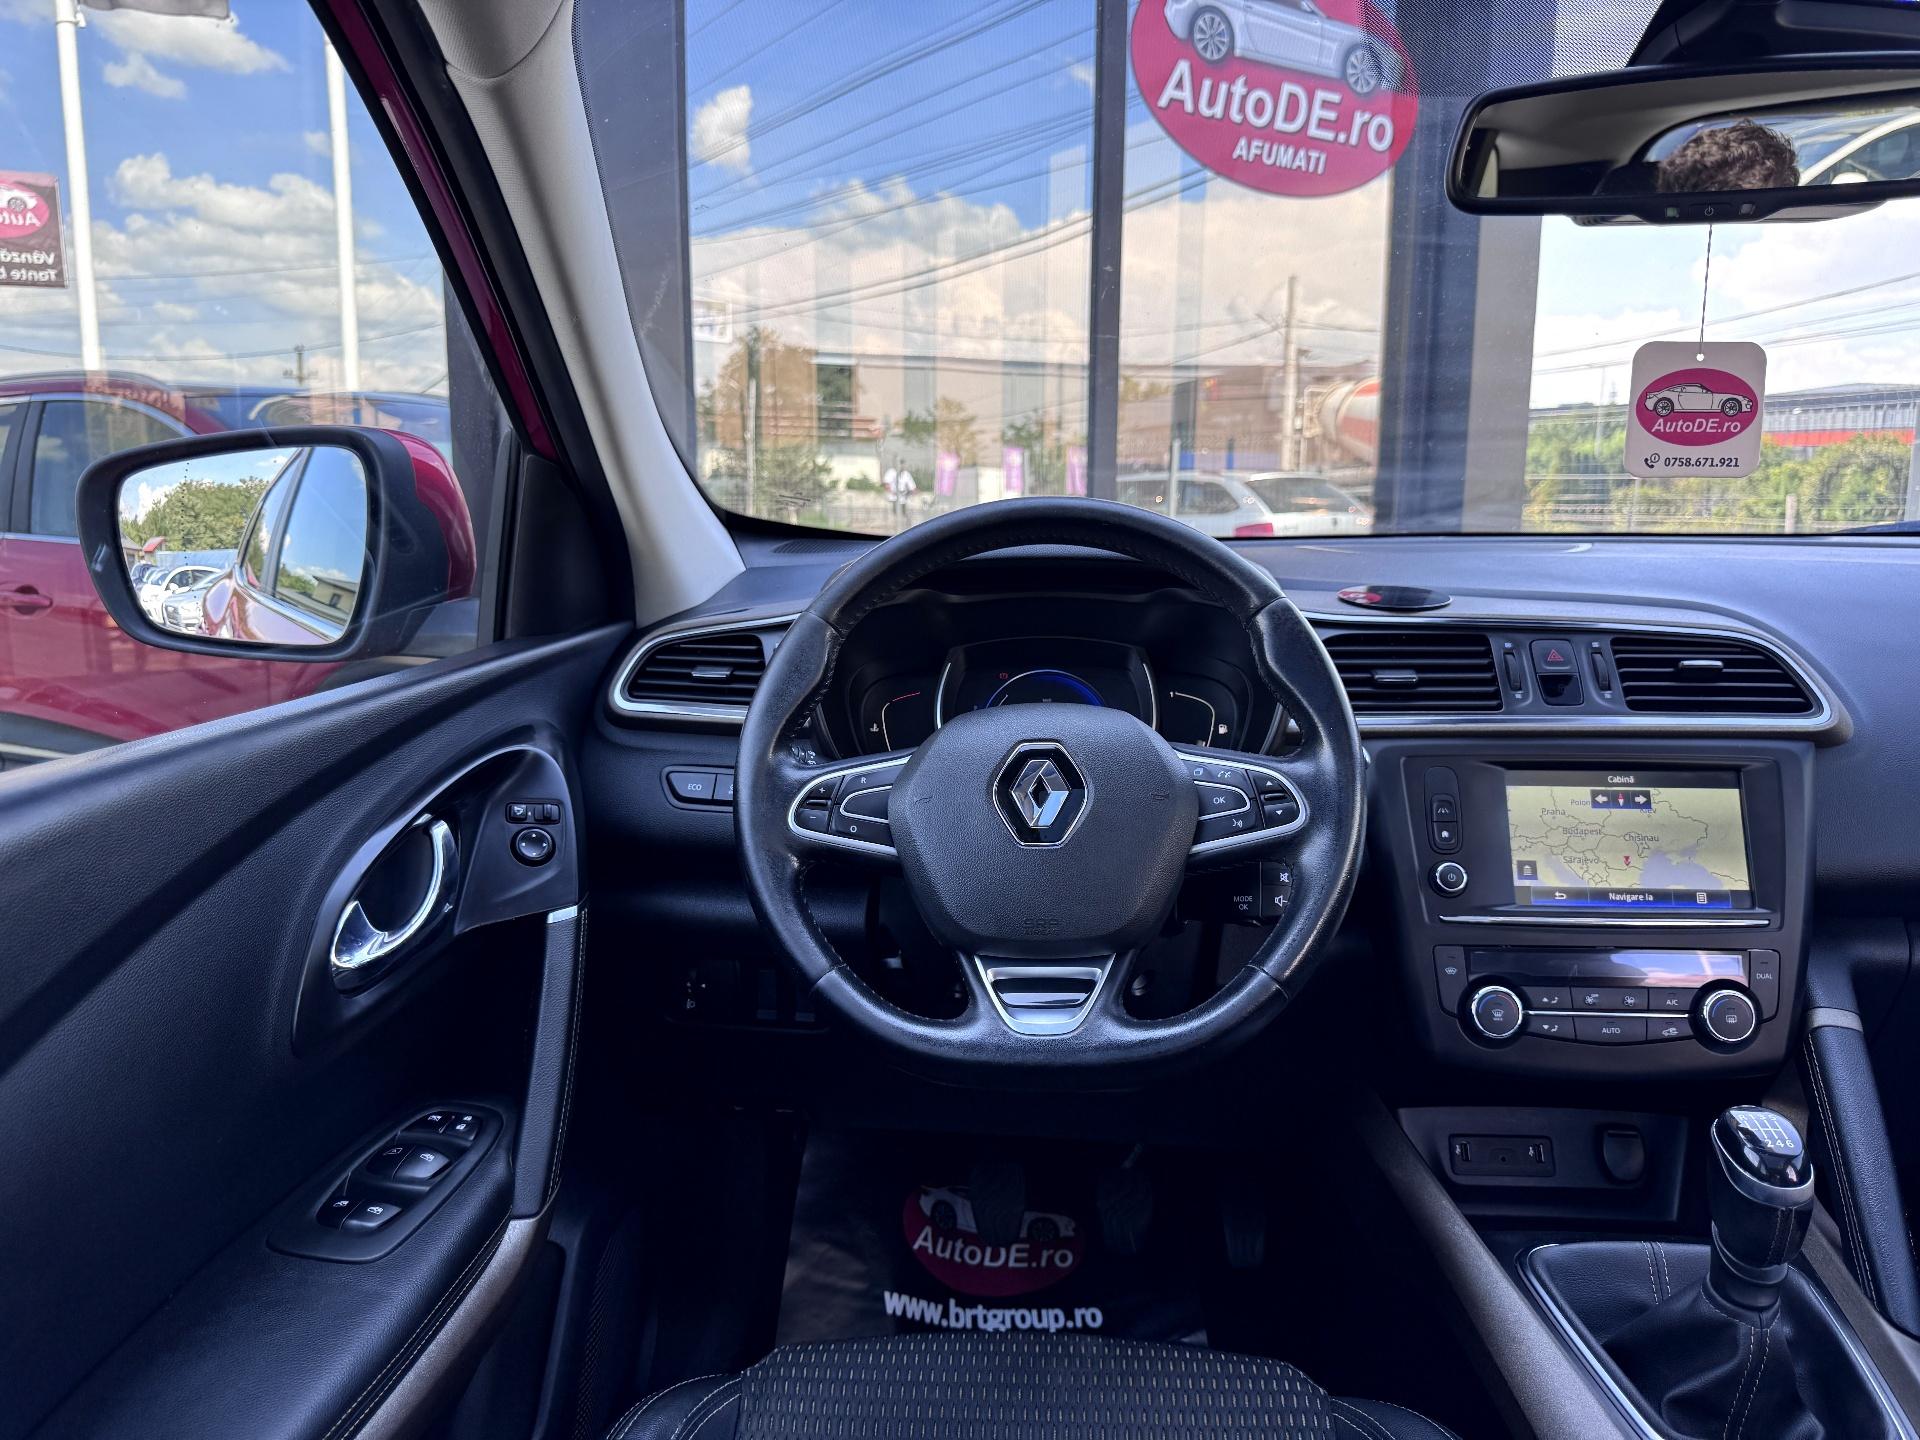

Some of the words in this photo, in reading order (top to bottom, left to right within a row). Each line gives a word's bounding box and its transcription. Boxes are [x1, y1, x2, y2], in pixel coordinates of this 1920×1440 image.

[1157, 58, 1395, 152] AutoDE.ro
[1232, 136, 1327, 175] AFUMATI
[1651, 418, 1741, 433] AutoDE.ro
[1664, 457, 1740, 468] 0758.671.921
[1607, 775, 1635, 784] Cabină
[687, 783, 702, 791] ECO
[1213, 796, 1226, 804] OK
[1541, 808, 1567, 816] Praha
[1562, 827, 1601, 838] Budapest
[1563, 855, 1600, 865] Sarajevo
[1608, 892, 1645, 903] Navigare
[1645, 893, 1654, 901] la
[1756, 972, 1773, 980] DUAL
[1765, 1139, 1775, 1148] 2
[1776, 1139, 1785, 1148] 4
[1785, 1140, 1795, 1148] 6
[911, 1225, 1075, 1269] AutoDE.ro
[884, 1290, 1104, 1333] www.brtgroup.ro
